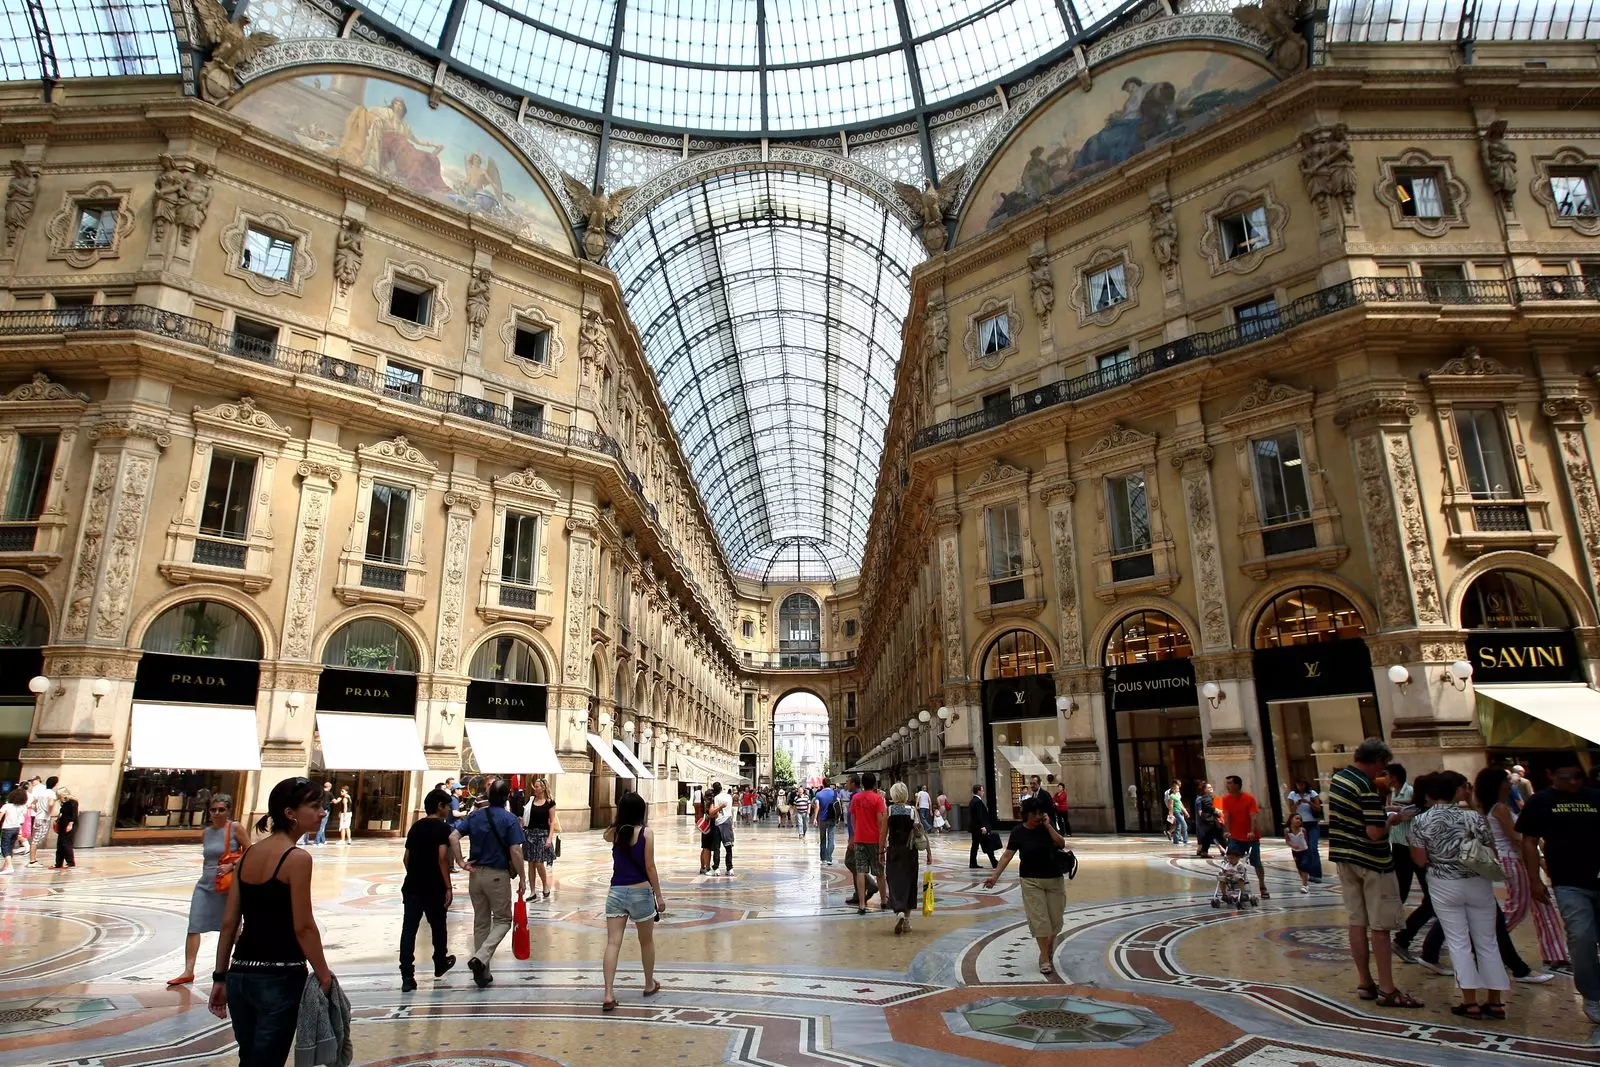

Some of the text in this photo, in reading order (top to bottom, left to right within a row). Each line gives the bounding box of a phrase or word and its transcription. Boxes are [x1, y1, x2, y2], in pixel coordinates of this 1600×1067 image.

[1479, 646, 1564, 668] SAVINI
[171, 674, 226, 686] PRADA
[1113, 676, 1190, 693] LOUIS VUITTON
[345, 687, 390, 698] PRADA
[488, 697, 525, 706] PRADA
